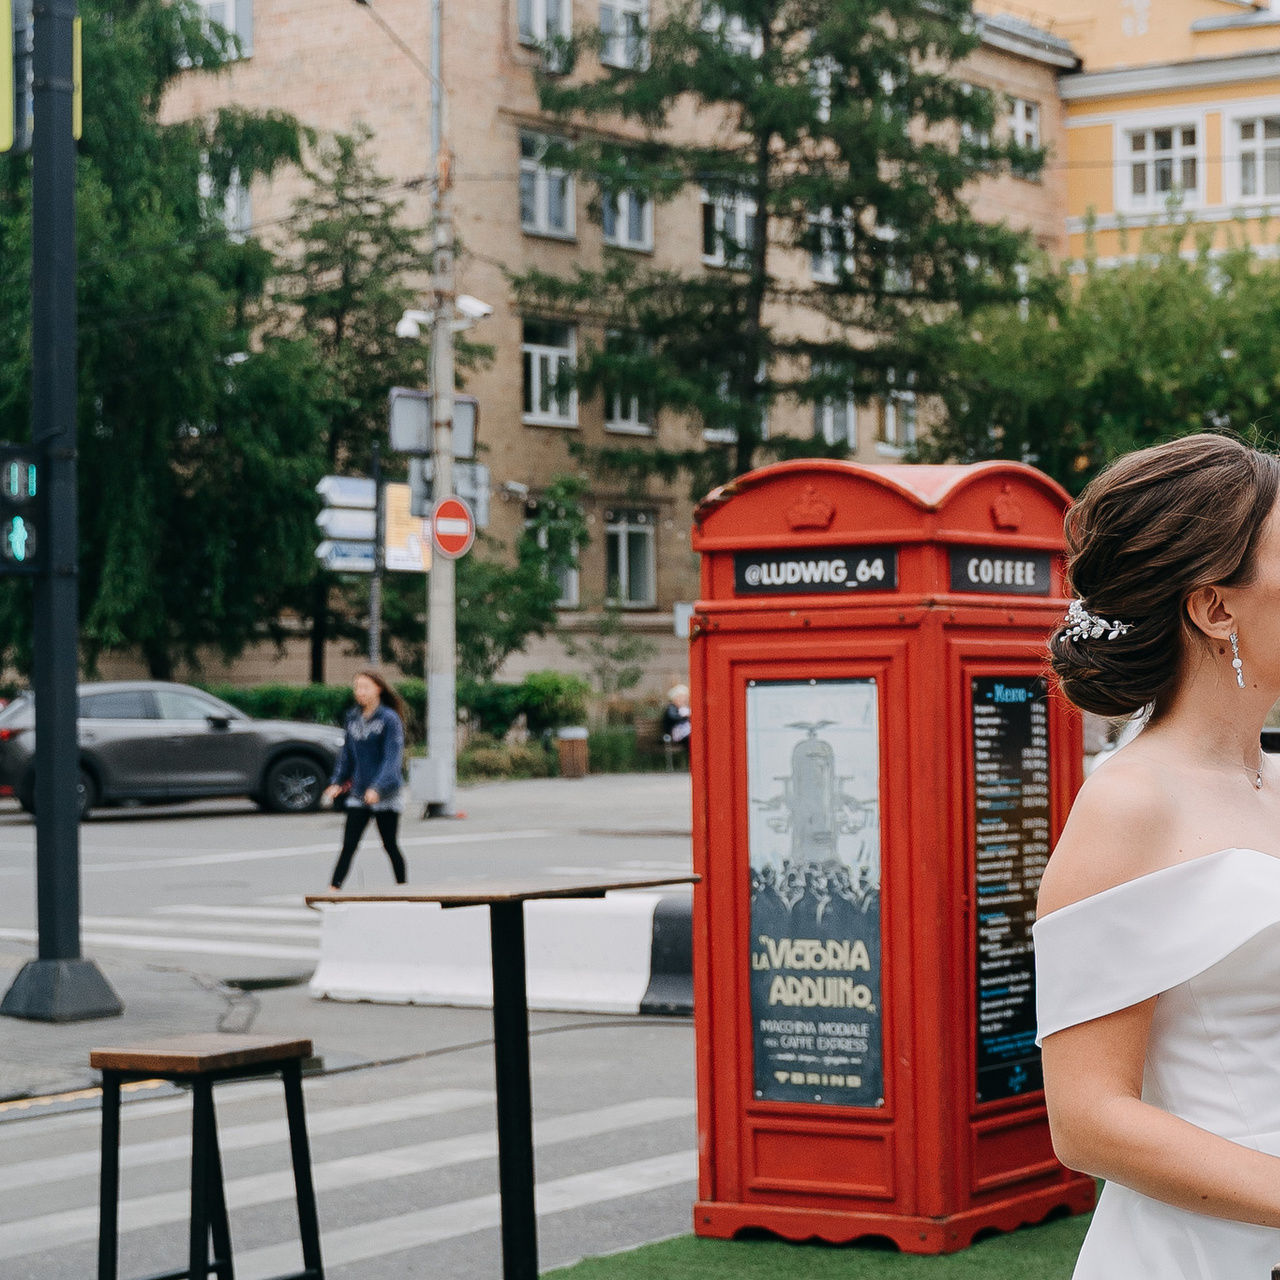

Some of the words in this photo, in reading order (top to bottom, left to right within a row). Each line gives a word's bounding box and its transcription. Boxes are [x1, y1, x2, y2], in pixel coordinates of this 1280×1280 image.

[745, 558, 885, 587] @LUDWIG_64
[967, 557, 1036, 586] COFFEE
[752, 952, 770, 971] LA
